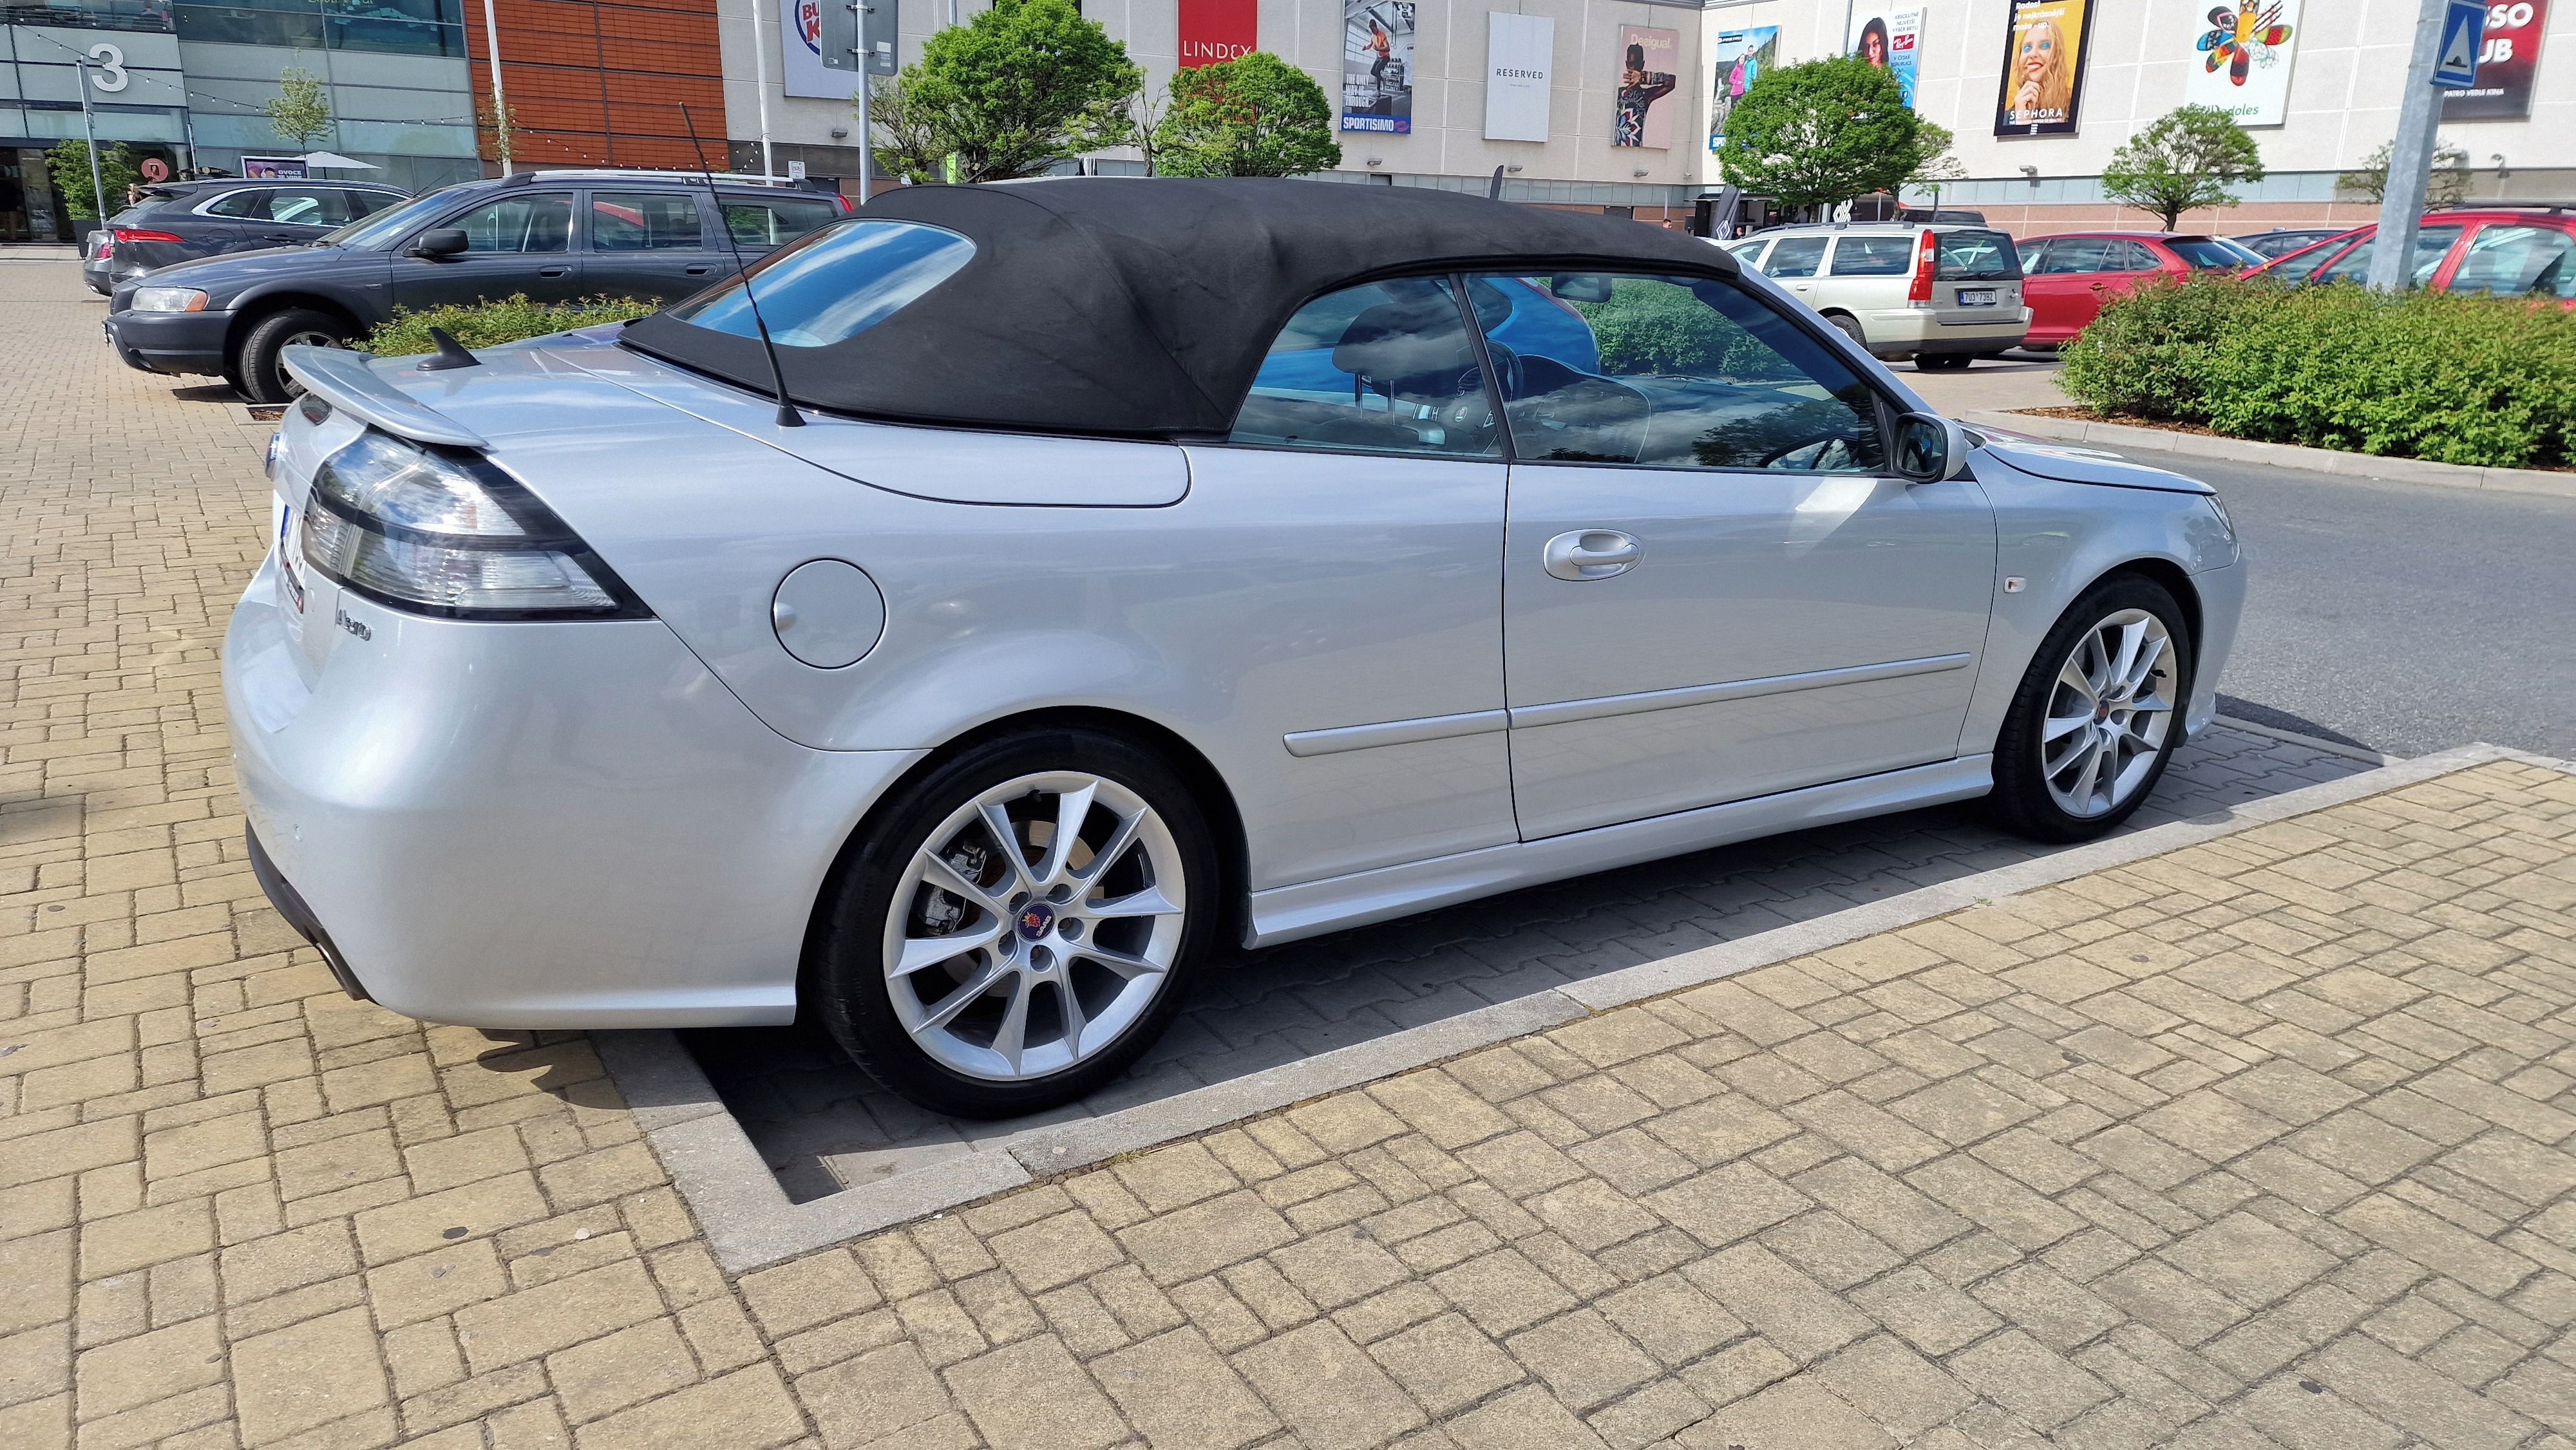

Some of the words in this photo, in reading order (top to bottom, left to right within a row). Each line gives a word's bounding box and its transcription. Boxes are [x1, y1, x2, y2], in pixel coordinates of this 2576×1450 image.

[90, 43, 128, 92] 3
[1496, 68, 1543, 79] RESERVED
[1346, 73, 1356, 84] THE
[1356, 74, 1369, 86] ONLY
[1346, 85, 1358, 95] WAY
[1359, 86, 1365, 95] IS
[2010, 108, 2063, 120] SEPHORA
[1343, 117, 1394, 131] SPORTISIMO
[1965, 293, 1975, 302] 7U3
[1980, 292, 1993, 301] 7392
[1036, 915, 1052, 937] SAAB
